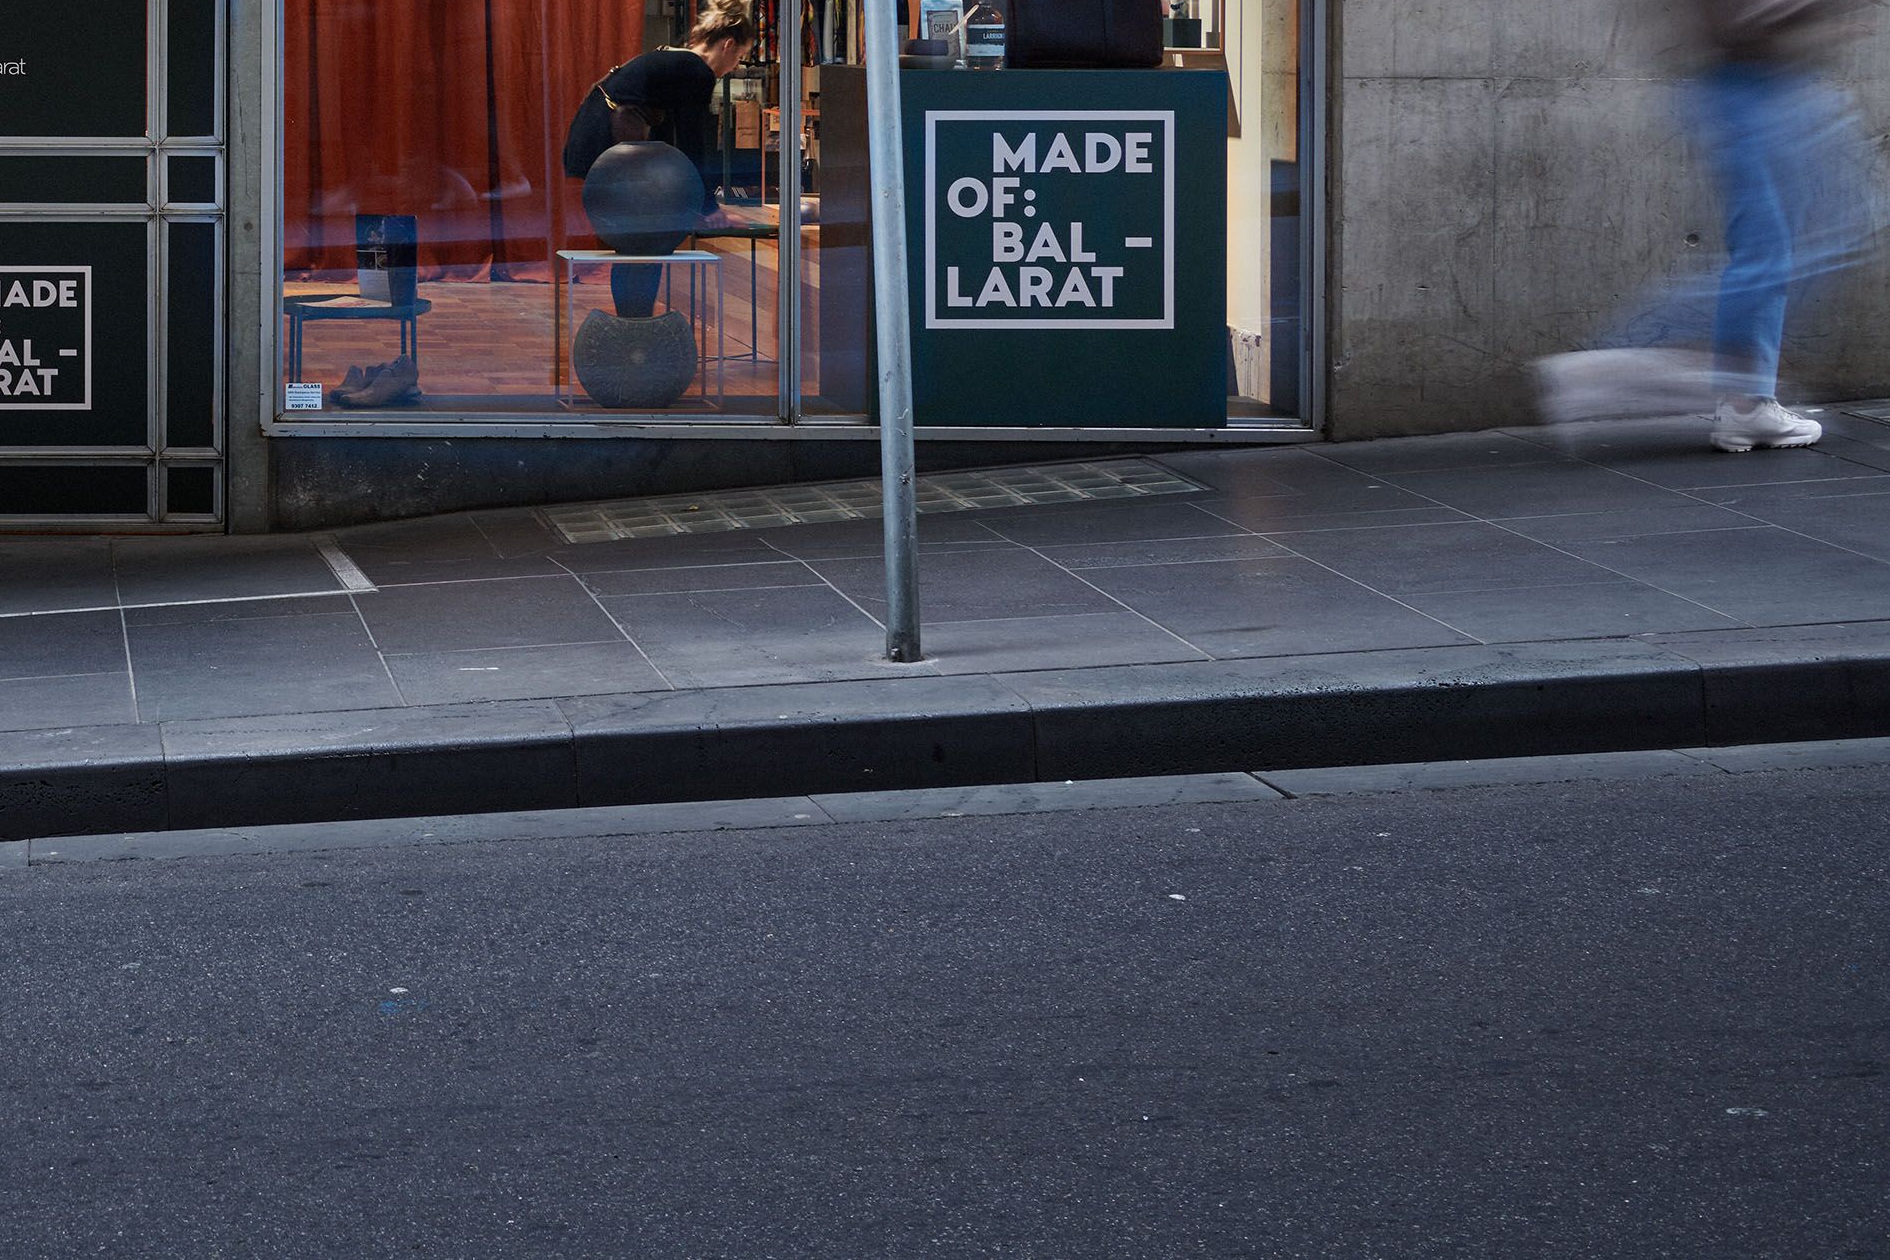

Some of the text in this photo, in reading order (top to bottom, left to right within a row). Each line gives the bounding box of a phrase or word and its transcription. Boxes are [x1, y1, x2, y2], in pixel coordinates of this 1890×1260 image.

[993, 132, 1152, 174] MADE
[947, 177, 1036, 218] OF:
[947, 267, 1123, 308] LARAT
